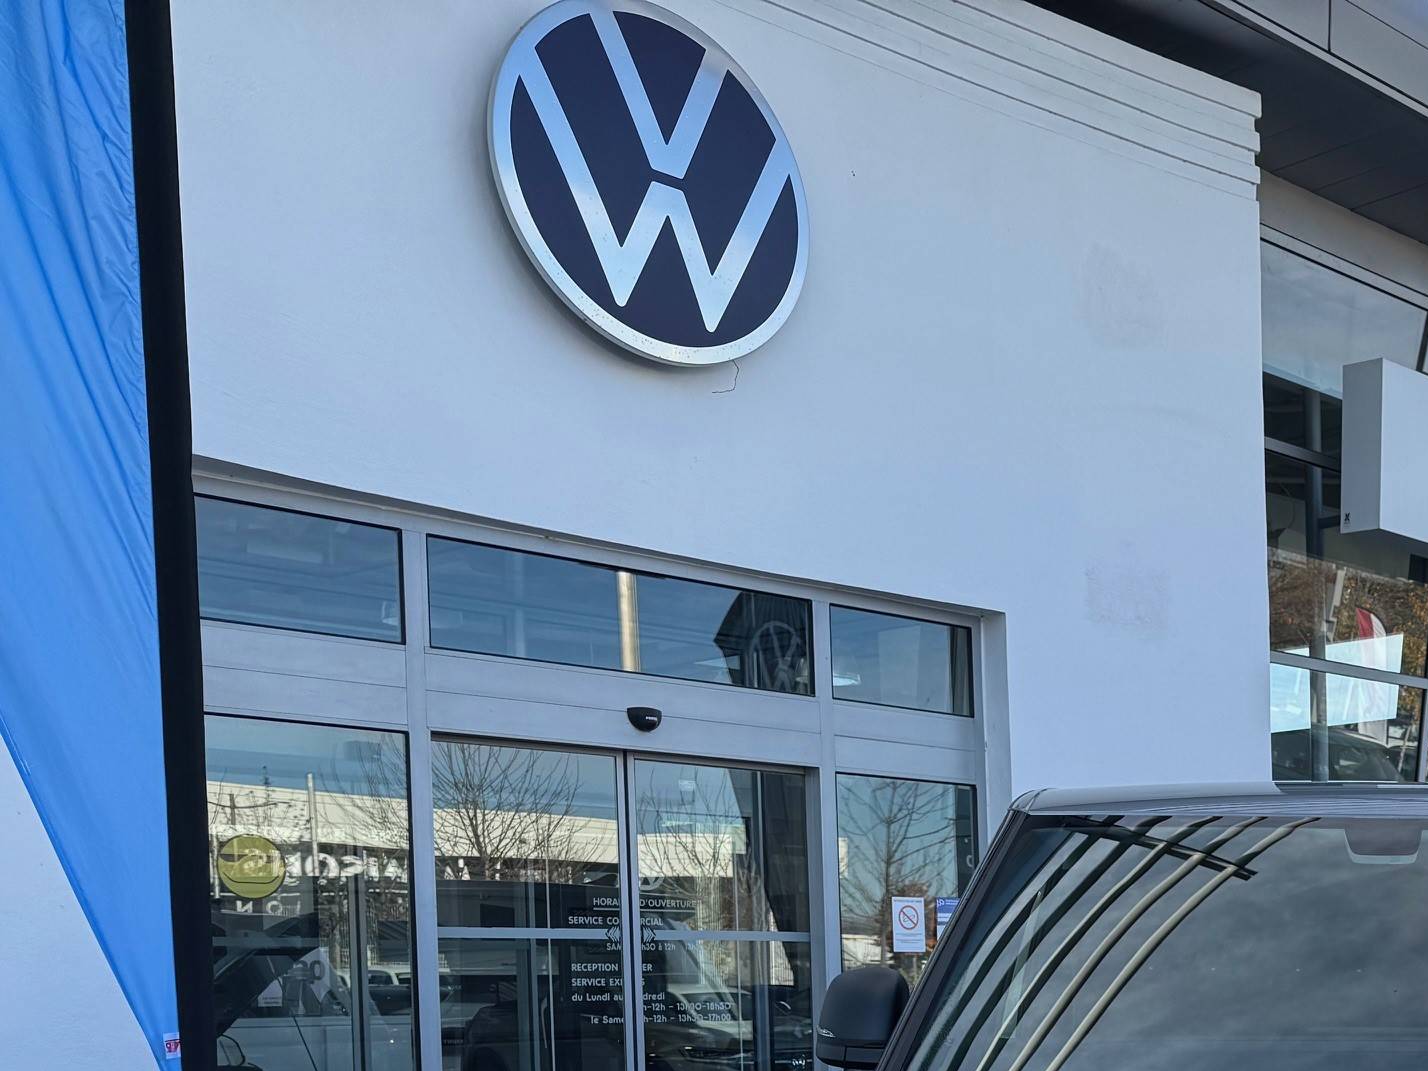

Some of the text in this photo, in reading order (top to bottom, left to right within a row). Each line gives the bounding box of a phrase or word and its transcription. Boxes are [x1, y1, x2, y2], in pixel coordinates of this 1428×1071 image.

[568, 916, 664, 926] SERVICE CORCIAL
[641, 943, 656, 951] h30
[571, 963, 619, 971] RECEPTION
[571, 978, 606, 986] SERVICE
[572, 993, 583, 1001] du
[586, 993, 610, 1001] Lundi
